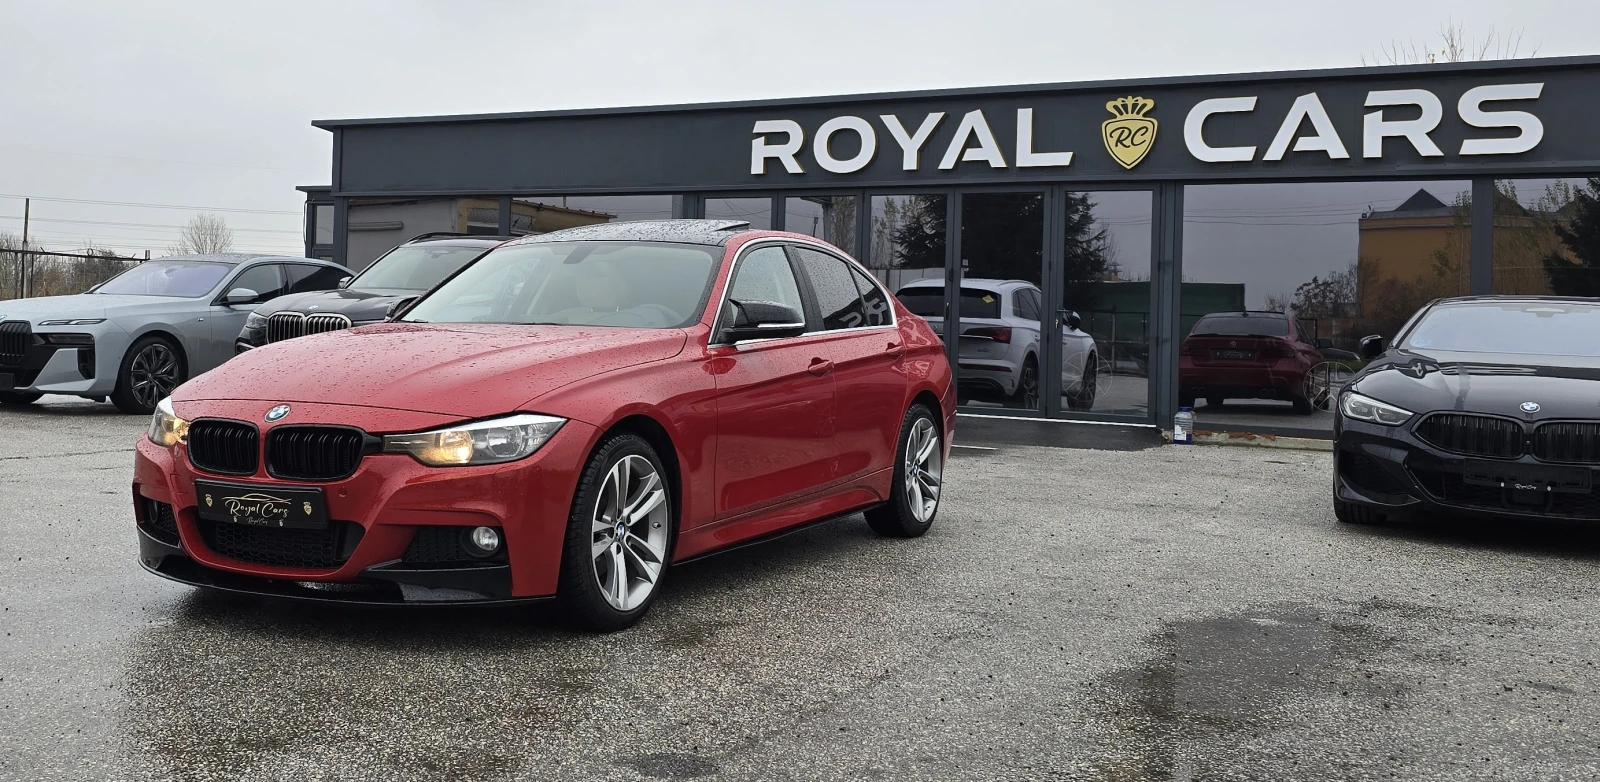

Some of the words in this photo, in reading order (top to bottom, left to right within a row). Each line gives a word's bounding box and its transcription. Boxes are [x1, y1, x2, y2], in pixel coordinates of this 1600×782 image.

[751, 107, 1074, 175] ROYAL
[1109, 126, 1149, 149] RC
[1183, 83, 1545, 163] CARS
[225, 499, 260, 516] Royal
[261, 502, 289, 518] Cars
